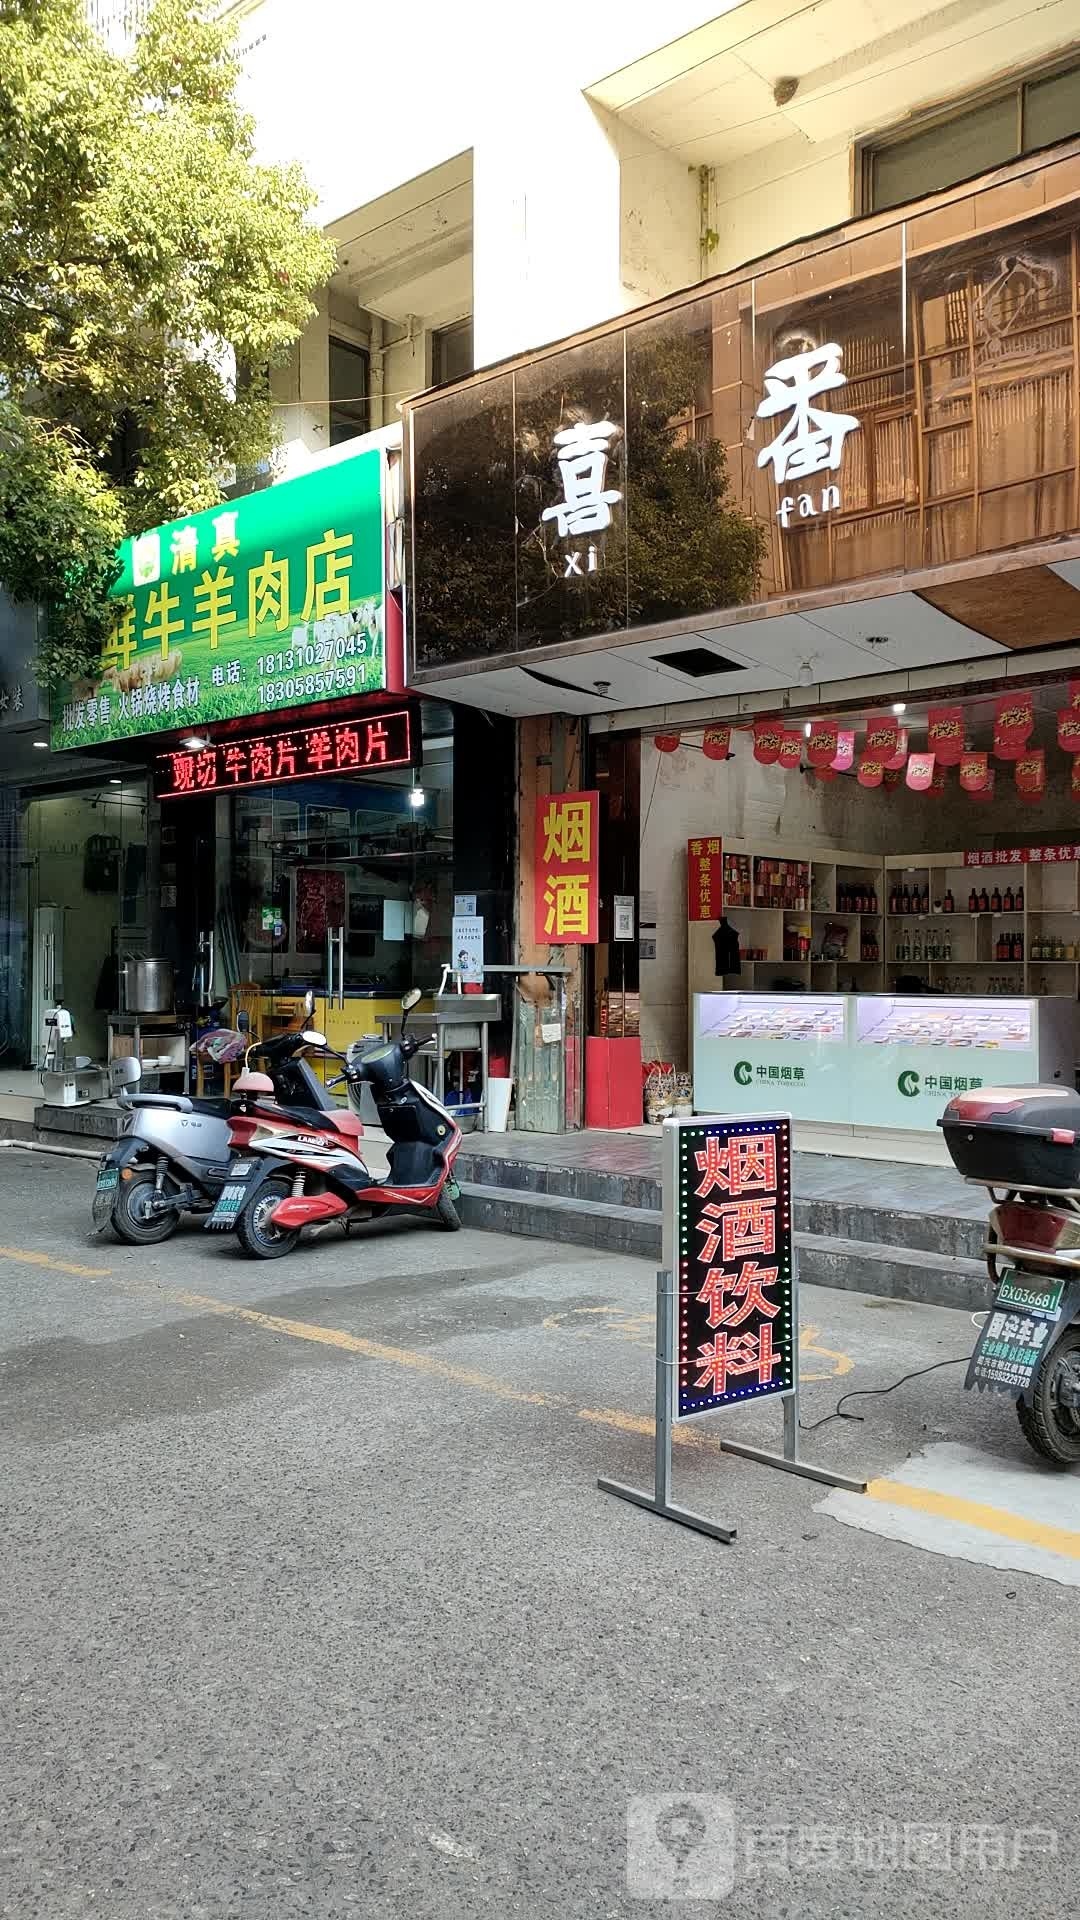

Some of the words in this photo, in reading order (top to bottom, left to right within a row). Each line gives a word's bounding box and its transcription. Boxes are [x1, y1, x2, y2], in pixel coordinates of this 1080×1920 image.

[542, 420, 623, 538] 喜
[756, 342, 861, 485] 番
[170, 510, 241, 576] 清真
[565, 545, 598, 578] xi
[776, 484, 841, 529] fan
[257, 632, 367, 676] 18131027045
[63, 696, 111, 732] 批发零售
[118, 676, 200, 721] 火锅烧烤食材
[257, 662, 367, 704] 18305857591
[543, 800, 592, 937] 烟酒
[690, 839, 720, 857] 香烟
[967, 849, 1023, 865] 烟酒批发
[699, 857, 712, 919] 整条优惠
[756, 1064, 806, 1081] 中国烟草
[924, 1074, 984, 1091] 中国烟草
[694, 1133, 782, 1396] 烟酒饮料
[1001, 1284, 1057, 1309] GX036681
